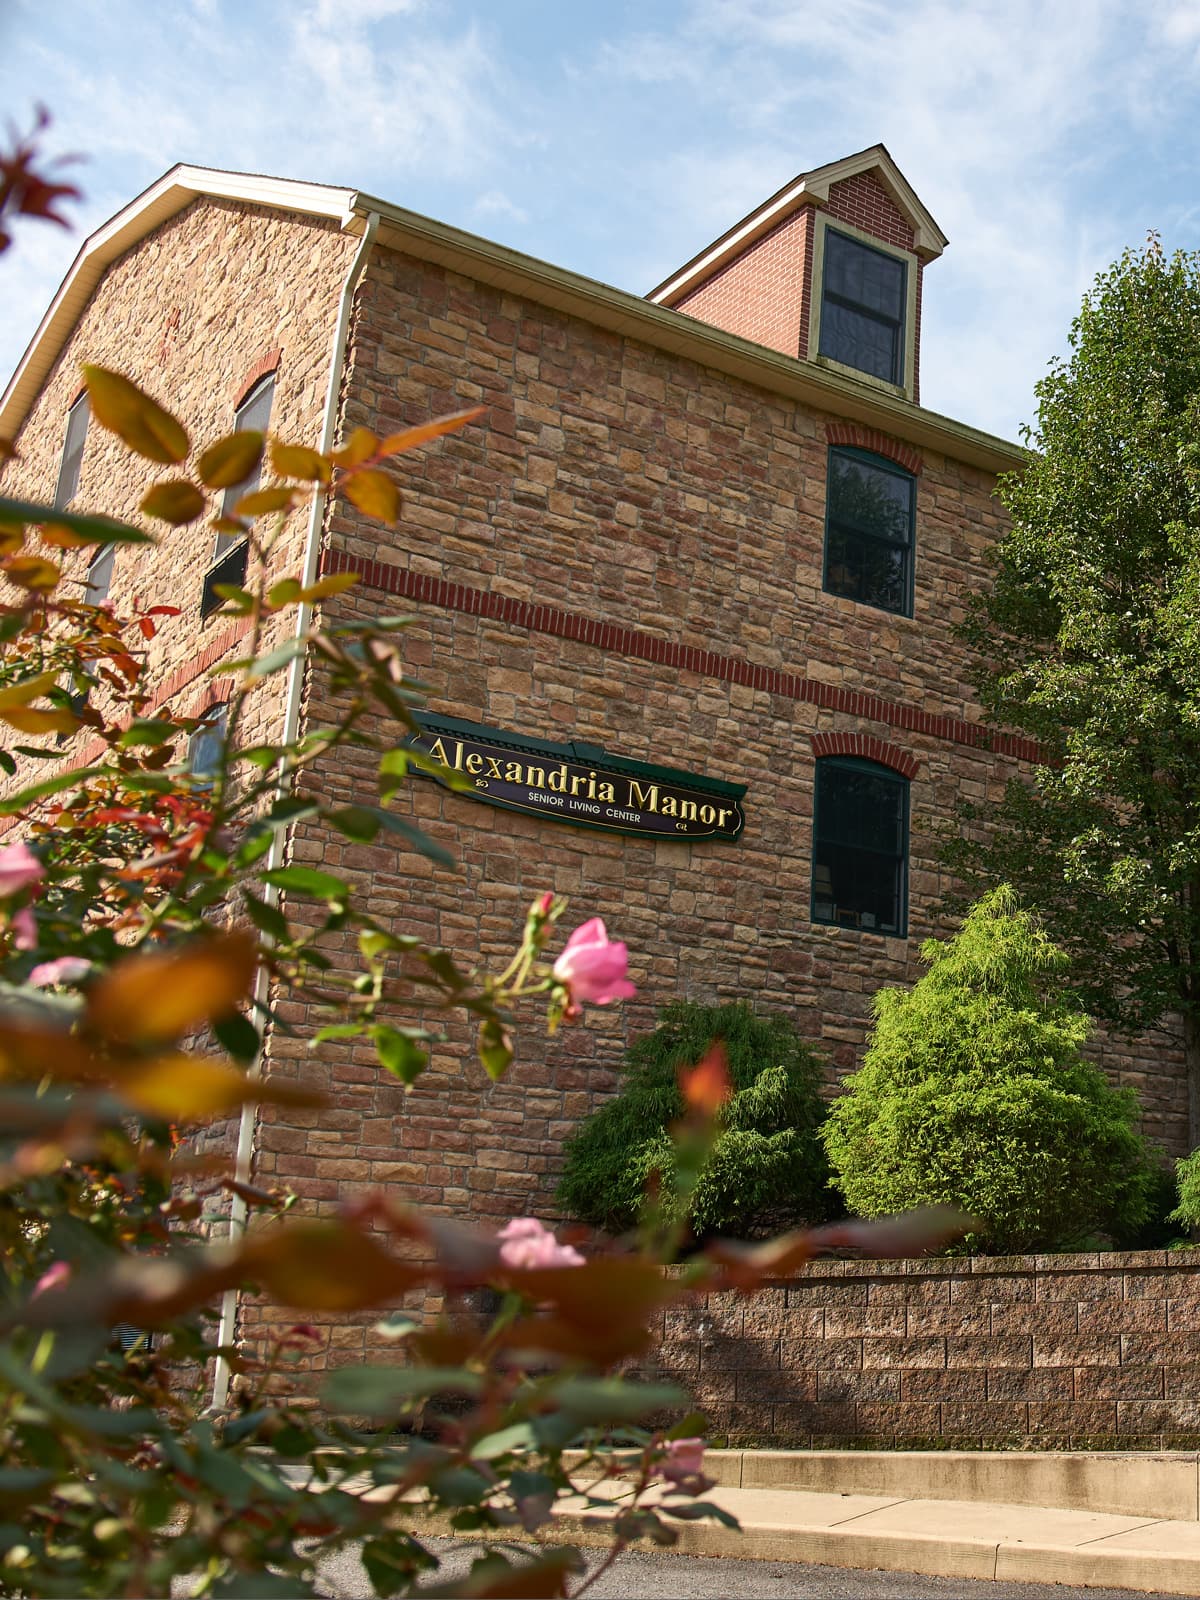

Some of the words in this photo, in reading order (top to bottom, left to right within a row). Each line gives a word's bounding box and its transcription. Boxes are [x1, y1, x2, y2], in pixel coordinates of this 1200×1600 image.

[428, 737, 615, 804] Alexandria
[625, 780, 733, 828] Manor
[528, 791, 564, 807] SENIOR
[569, 800, 601, 815] LIVING
[606, 808, 641, 823] CENTER
